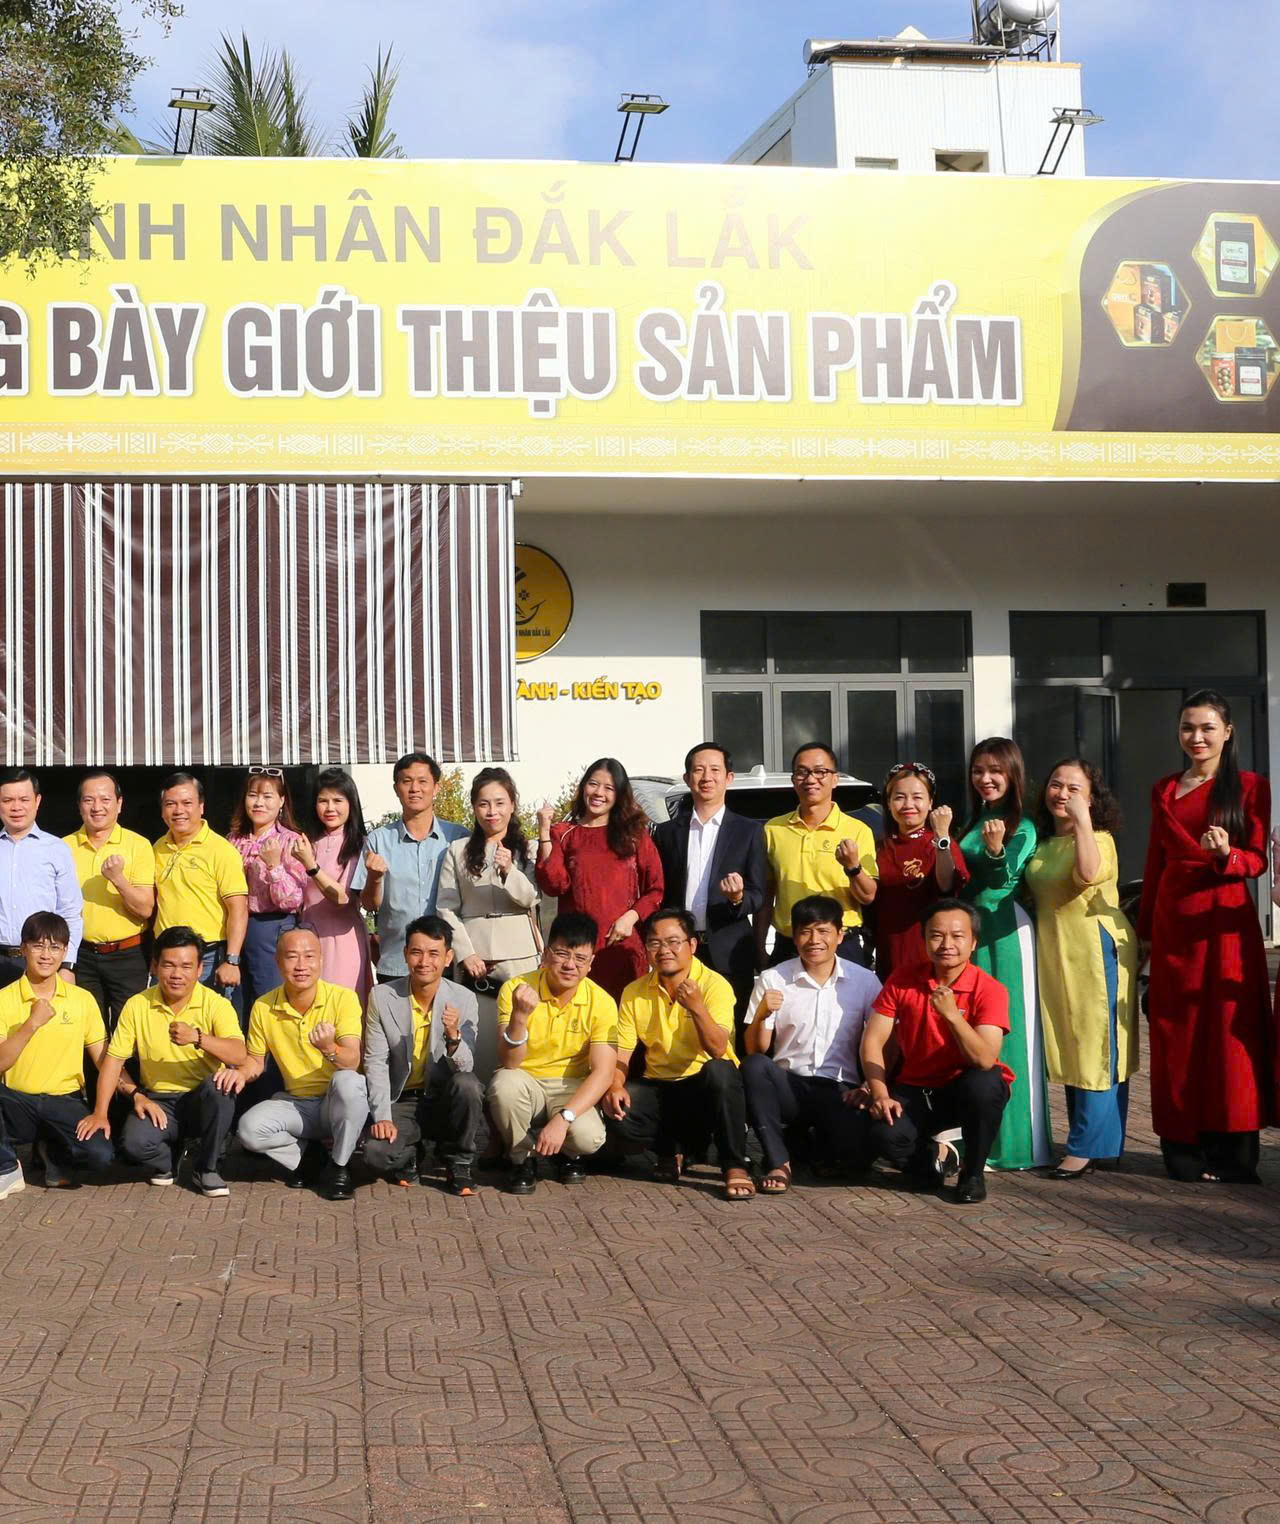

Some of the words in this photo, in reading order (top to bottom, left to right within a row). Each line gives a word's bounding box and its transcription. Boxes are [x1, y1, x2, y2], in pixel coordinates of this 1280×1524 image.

[221, 188, 442, 264] NHÂN
[472, 180, 637, 266] ĐẮK
[666, 187, 814, 271] LẮK
[53, 288, 200, 391] BÀY
[227, 290, 377, 393] GIỚI
[402, 292, 616, 413] THIỆU
[639, 284, 784, 397] SẢN
[811, 284, 1017, 400] PHẨM
[517, 678, 558, 700] ÀNH
[572, 675, 619, 700] KIẾN
[622, 681, 662, 705] TẠO
